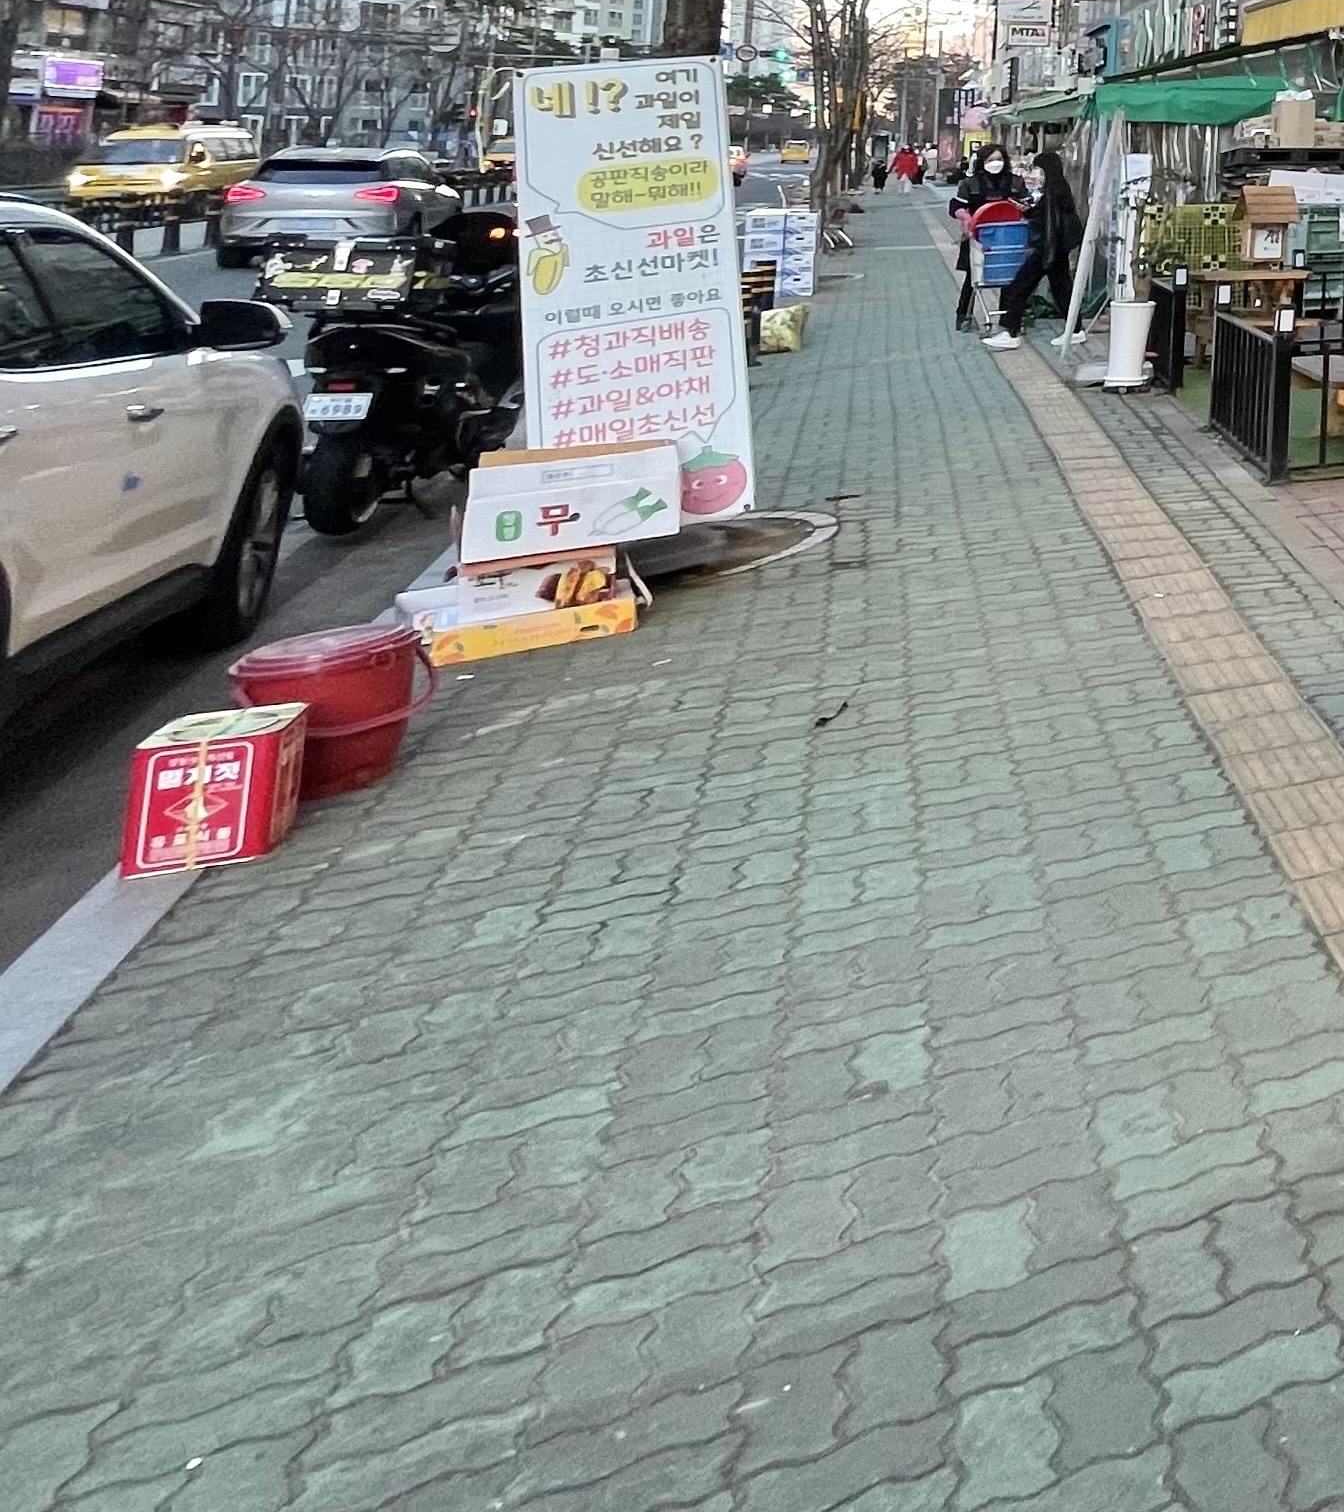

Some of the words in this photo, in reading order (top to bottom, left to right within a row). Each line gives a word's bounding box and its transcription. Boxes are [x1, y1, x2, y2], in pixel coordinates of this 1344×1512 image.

[655, 68, 699, 86] 여기
[634, 89, 701, 110] 과일이
[657, 110, 701, 130] 제일
[590, 160, 708, 189] 공판직송이라
[646, 224, 721, 250] 과일은
[583, 248, 719, 284] 초신선마켓!
[545, 304, 601, 326] 이럴때
[609, 295, 662, 316] 오시면
[549, 318, 710, 360] #청과직배송
[552, 375, 711, 420] #과일&야채
[553, 403, 716, 450] #매일초신선
[535, 504, 571, 536] 무
